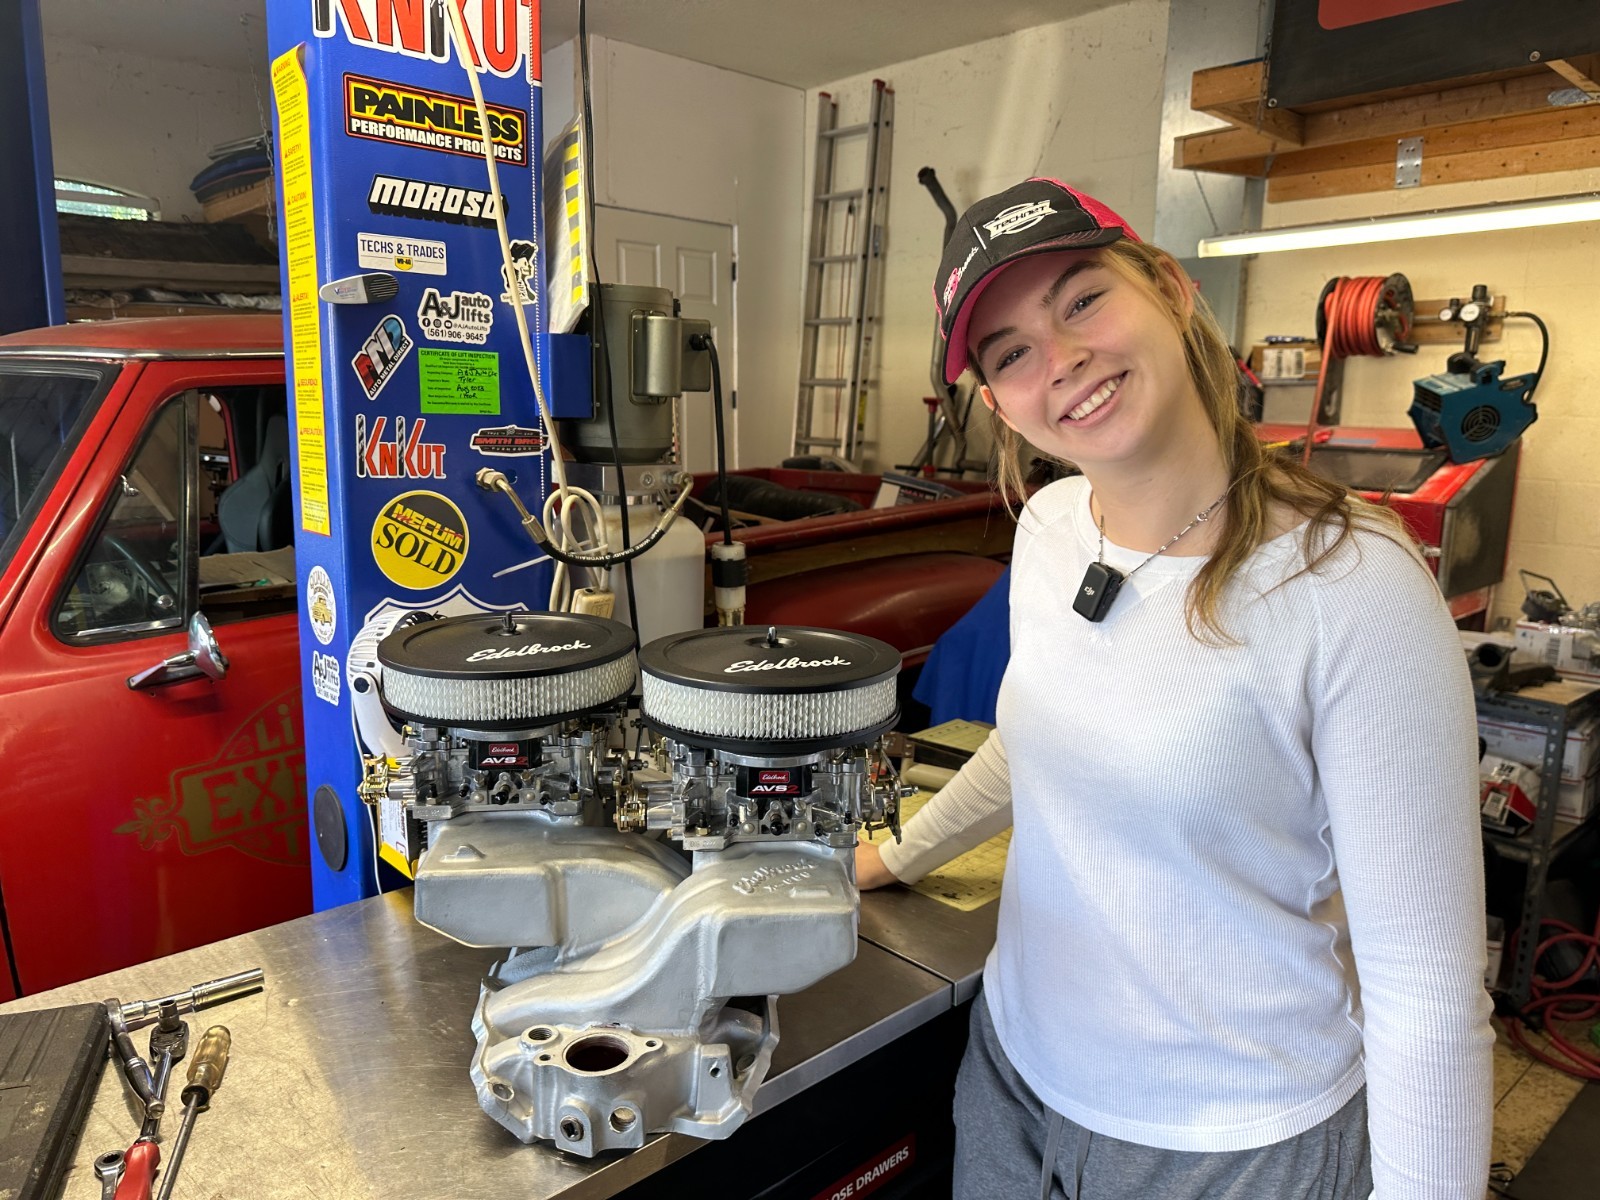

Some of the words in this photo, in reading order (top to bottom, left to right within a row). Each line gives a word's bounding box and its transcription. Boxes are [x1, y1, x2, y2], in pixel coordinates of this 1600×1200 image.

[316, 0, 541, 80] NUT
[354, 86, 519, 142] PAINLESS
[351, 118, 452, 149] PERFORMANCE
[360, 239, 394, 254] TECHS
[396, 243, 405, 256] &
[406, 243, 445, 259] TRADES
[421, 291, 460, 319] A&J
[461, 295, 490, 308] auto
[461, 307, 490, 323] lifts
[369, 379, 382, 396] AUTO
[380, 361, 395, 380] METAL
[393, 340, 410, 362] DIRECT
[392, 503, 464, 549] MECUM
[376, 522, 456, 575] SOLD
[465, 639, 592, 663] Edelbrock
[724, 655, 851, 674] Edelbrock
[482, 756, 528, 764] AVS2
[752, 785, 799, 793] AVS2
[828, 1182, 855, 1200] OSE
[855, 1146, 909, 1191] DRAWERS
